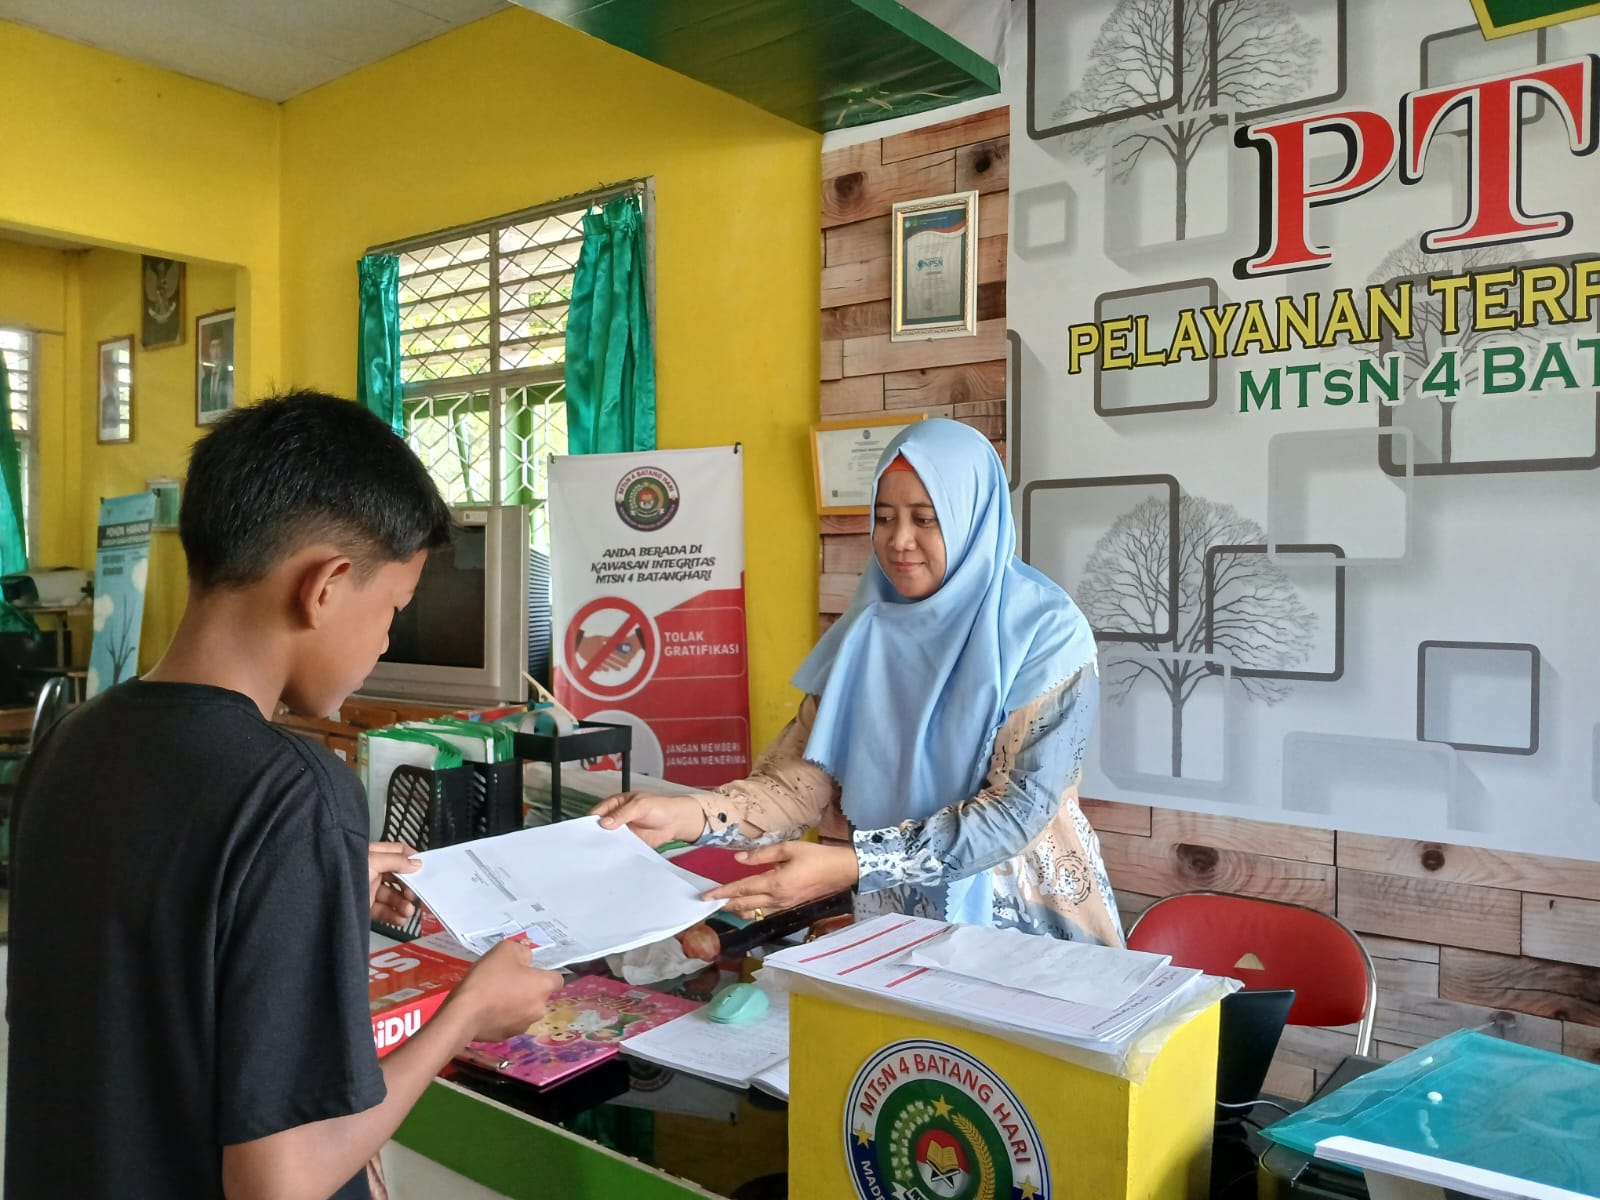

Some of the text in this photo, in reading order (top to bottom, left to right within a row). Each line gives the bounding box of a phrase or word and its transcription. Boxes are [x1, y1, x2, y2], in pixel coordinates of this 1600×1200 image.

[1067, 280, 1415, 375] PELAYANAN
[1238, 357, 1400, 413] MTsN
[1422, 351, 1461, 397] 4
[602, 544, 702, 558] ANDA BERADA DI
[591, 556, 716, 574] KAWASAN INTEGRITAS
[627, 573, 634, 583] 4
[636, 569, 712, 583] BATANGHARI
[664, 630, 704, 643] TOLAK
[664, 643, 739, 657] GRATIFIKASI
[666, 742, 741, 754] JANGAN MEMBERI
[666, 755, 746, 767] JANGAN MENERIMA
[372, 1009, 421, 1049] iDU
[899, 1056, 910, 1076] 4
[913, 1053, 994, 1104] BATANG
[992, 1102, 1031, 1163] HARI
